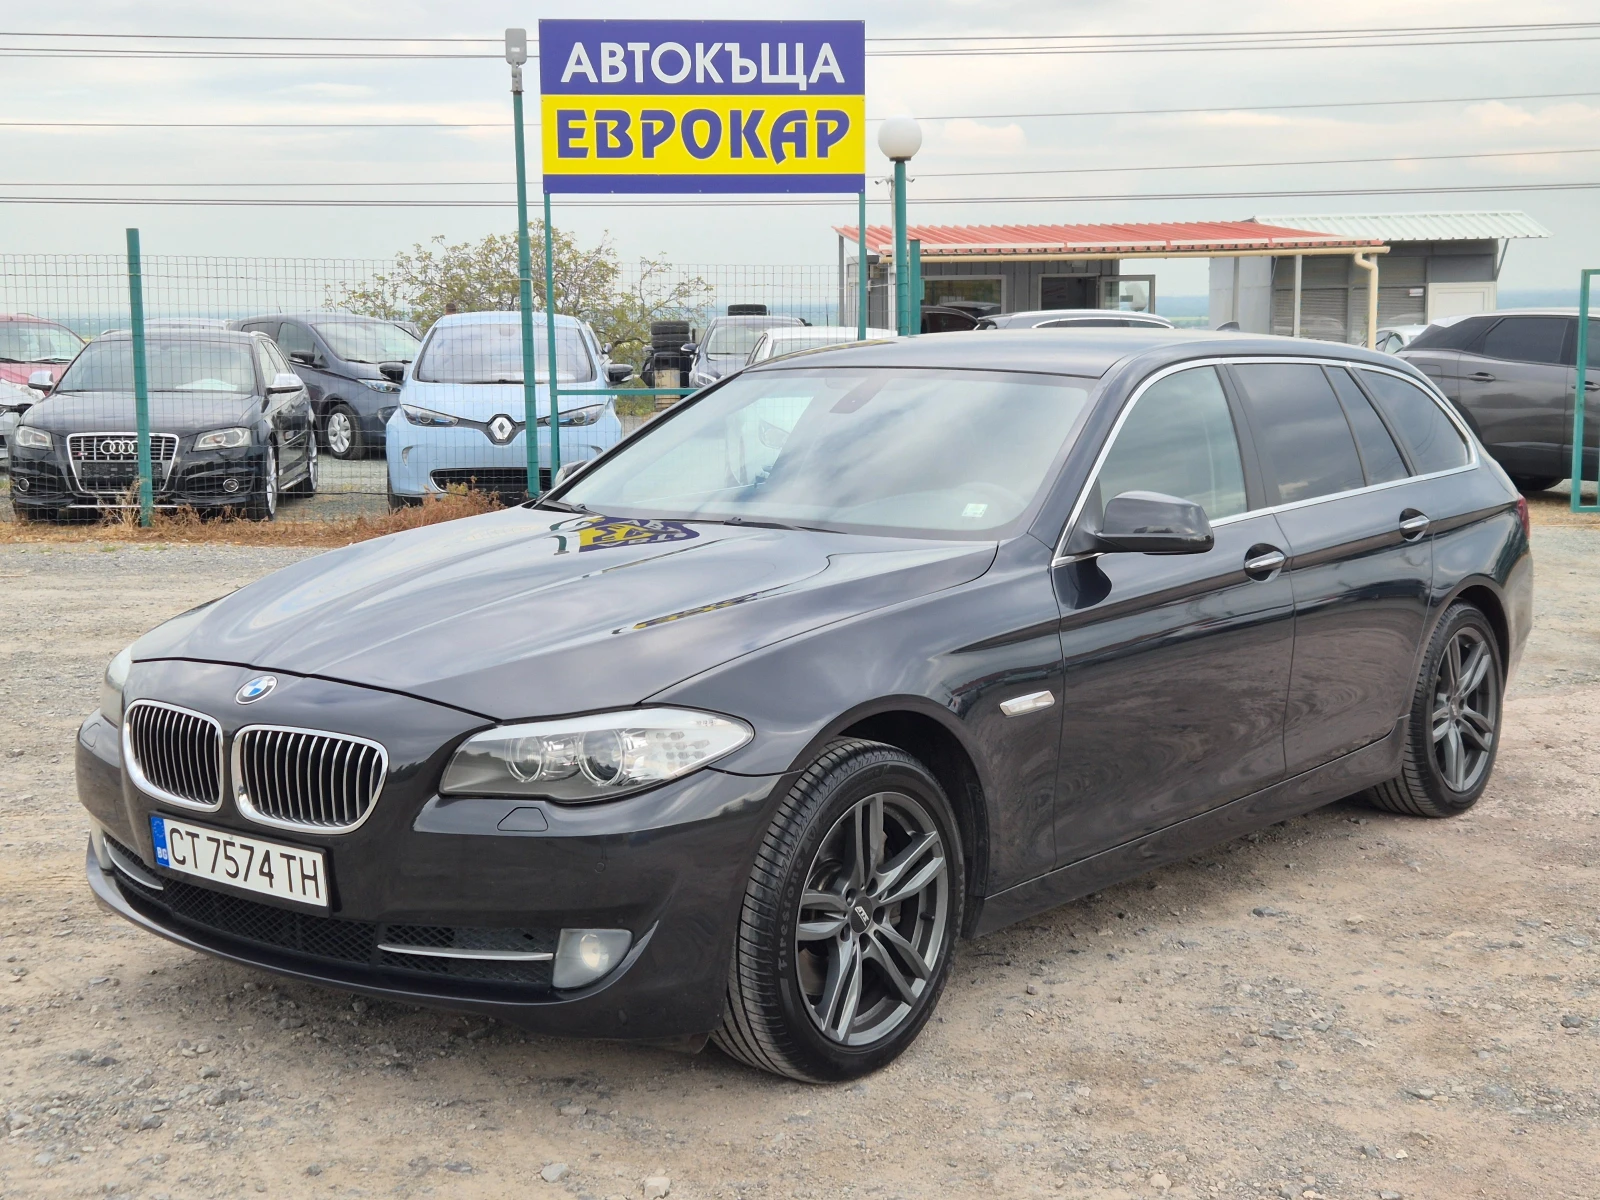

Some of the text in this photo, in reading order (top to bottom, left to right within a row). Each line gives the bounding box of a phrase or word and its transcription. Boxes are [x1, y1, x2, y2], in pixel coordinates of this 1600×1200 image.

[560, 41, 845, 91] АВТОКЪЩА
[556, 108, 850, 165] ЕВРОКАР
[157, 846, 168, 860] BG
[169, 827, 320, 899] CT 7574 TH
